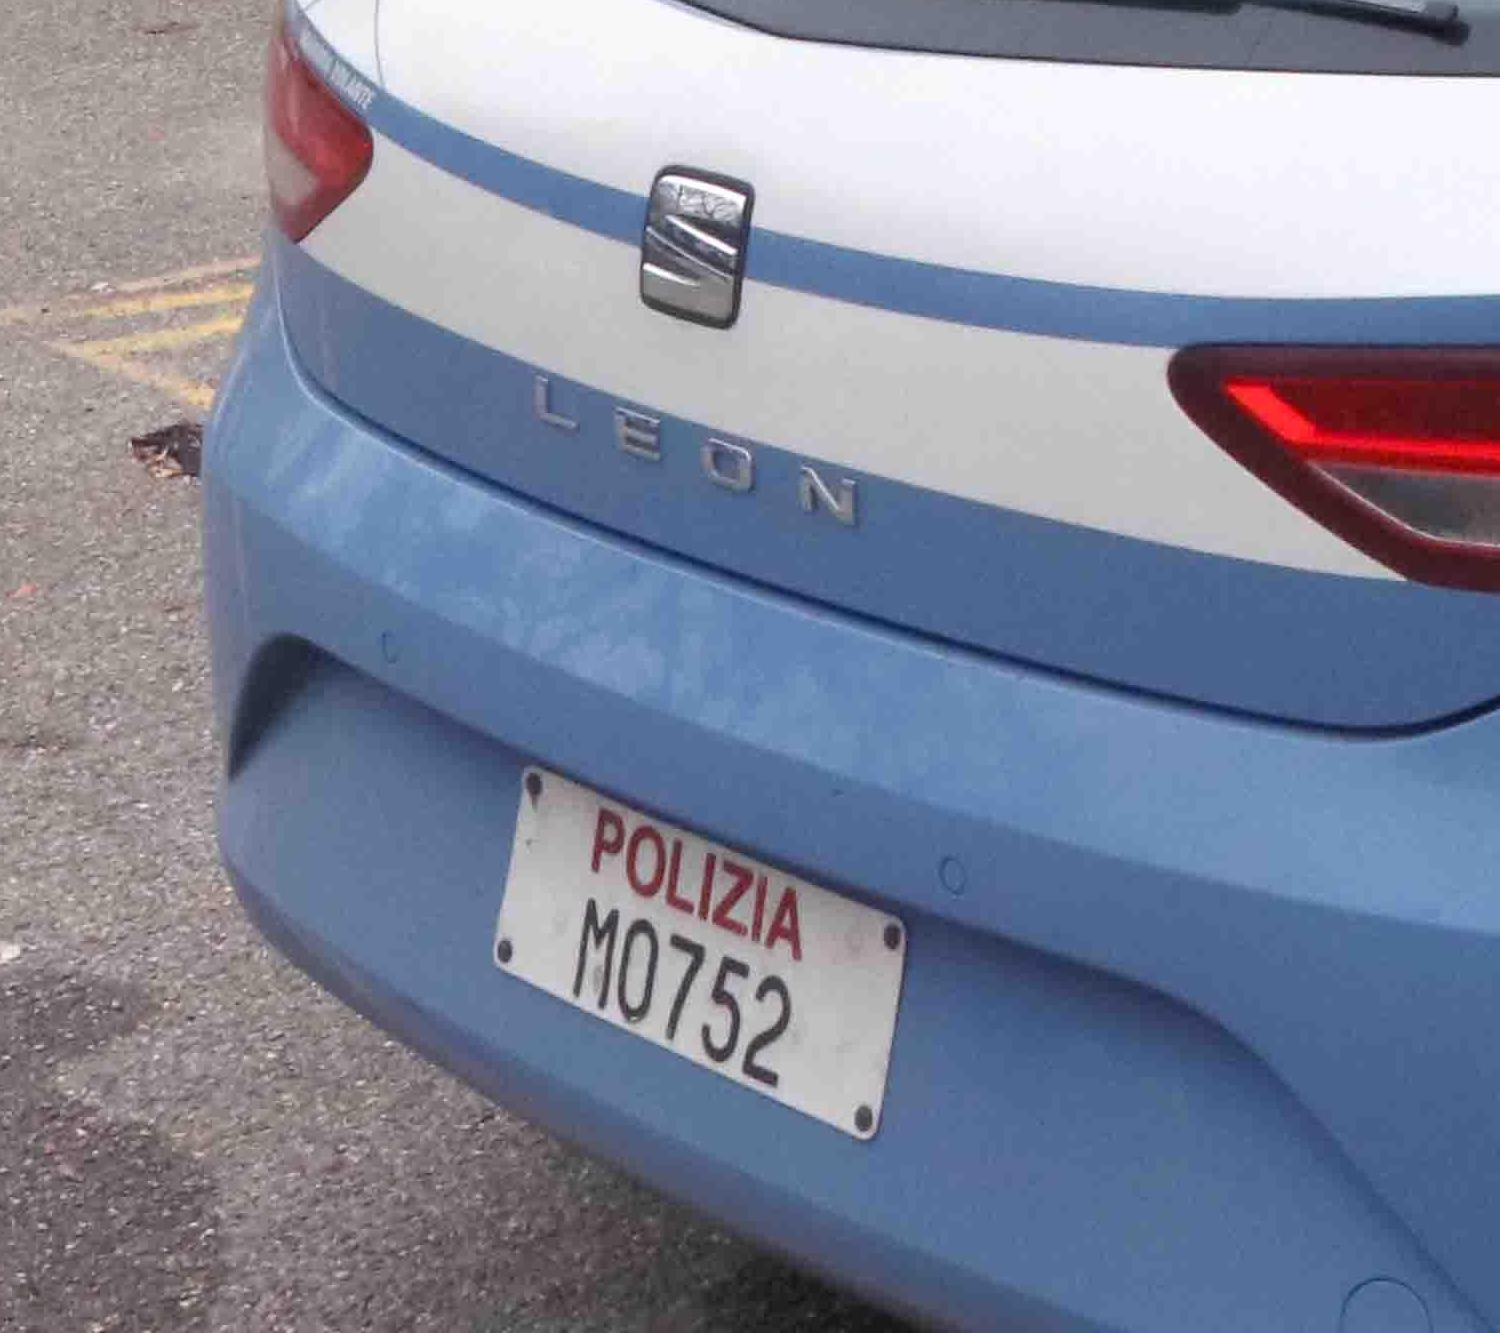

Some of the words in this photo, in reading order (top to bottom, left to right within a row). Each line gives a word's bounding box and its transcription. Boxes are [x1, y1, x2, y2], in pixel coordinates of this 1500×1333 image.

[532, 374, 861, 527] LEON
[591, 808, 803, 962] POLIZIA
[572, 898, 793, 1087] M0752
